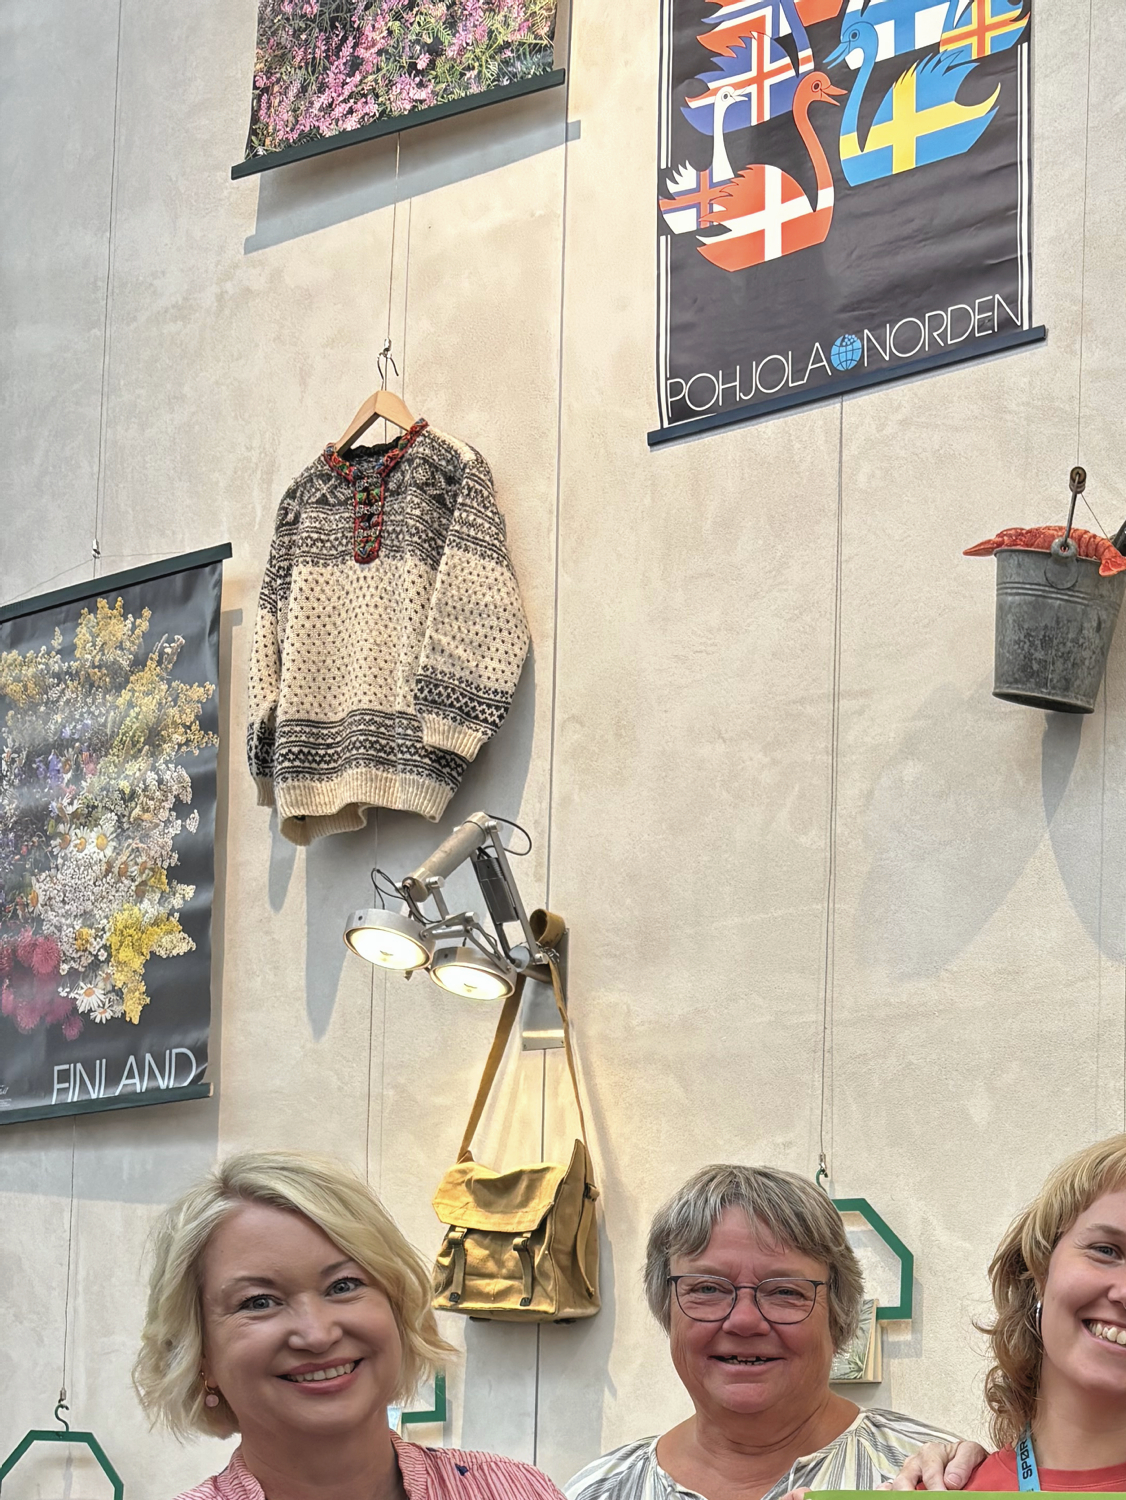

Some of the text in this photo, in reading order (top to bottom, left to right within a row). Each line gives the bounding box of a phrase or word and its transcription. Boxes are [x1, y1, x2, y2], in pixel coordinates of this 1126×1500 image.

[666, 294, 1022, 418] POHJOLA NORDEN
[51, 1047, 197, 1105] FINLAND
[1019, 1438, 1033, 1480] SPØR
